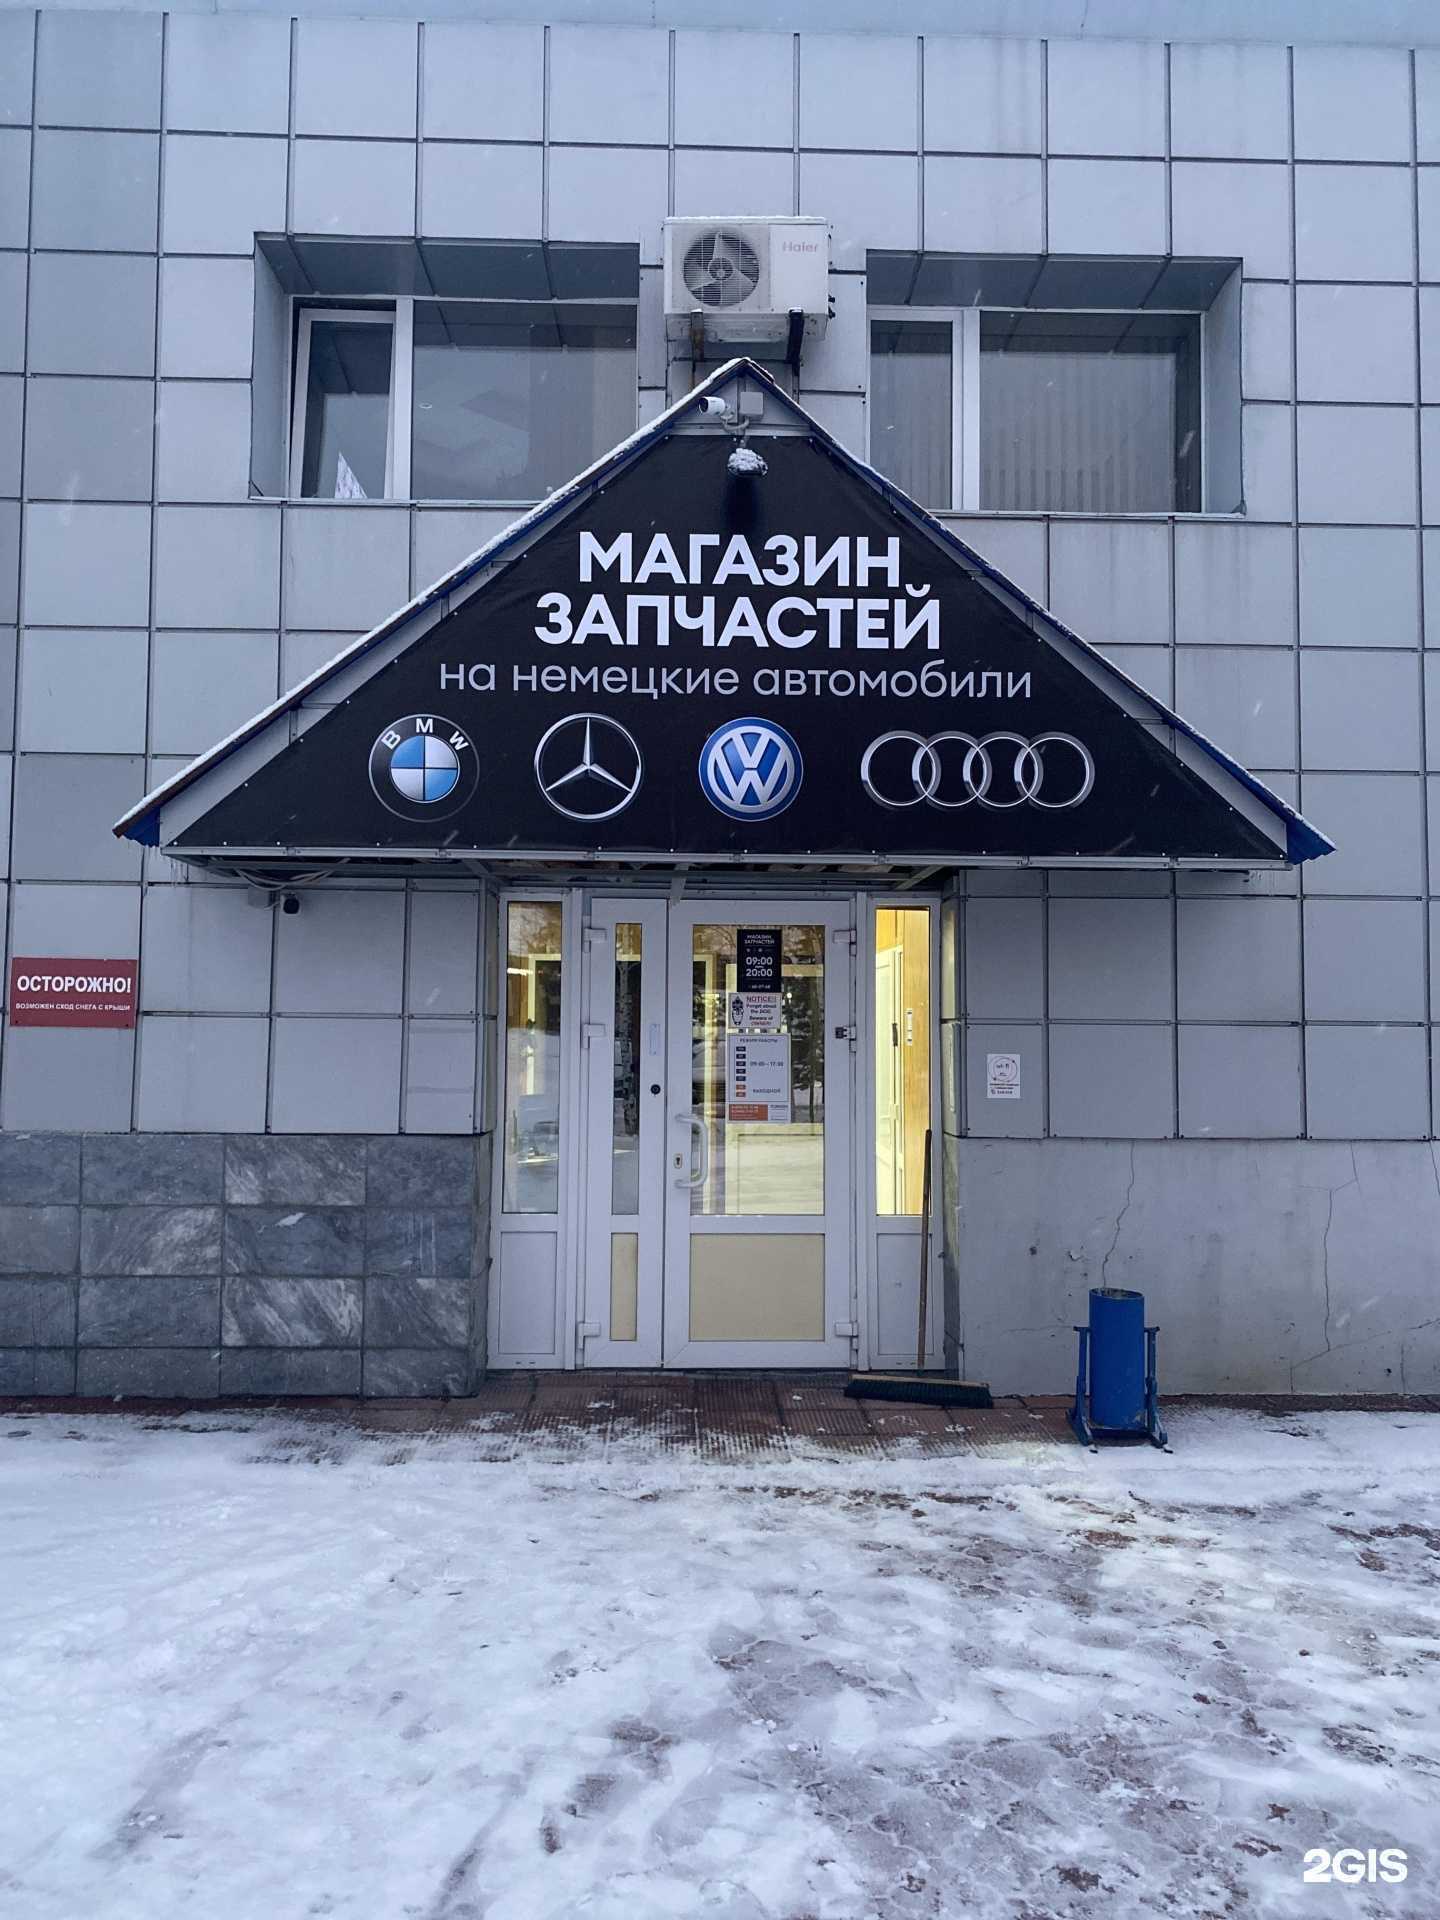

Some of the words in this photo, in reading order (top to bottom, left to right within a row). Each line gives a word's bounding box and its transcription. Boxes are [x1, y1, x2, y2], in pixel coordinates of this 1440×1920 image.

[783, 241, 818, 252] Haier
[579, 532, 900, 588] МАГАЗИН
[534, 584, 940, 650] ЗАПЧАСТЕЙ
[439, 662, 496, 691] на
[513, 664, 739, 700] немецкие
[753, 659, 1031, 698] автомобили
[381, 718, 469, 752] BMW
[707, 725, 797, 812] VW
[745, 957, 773, 966] 09:00
[745, 968, 773, 977] 20:00
[17, 975, 132, 993] ОСТОРОЖНО!
[15, 1002, 54, 1010] ВОЗМОЖЕН
[55, 1003, 74, 1011] СХОД
